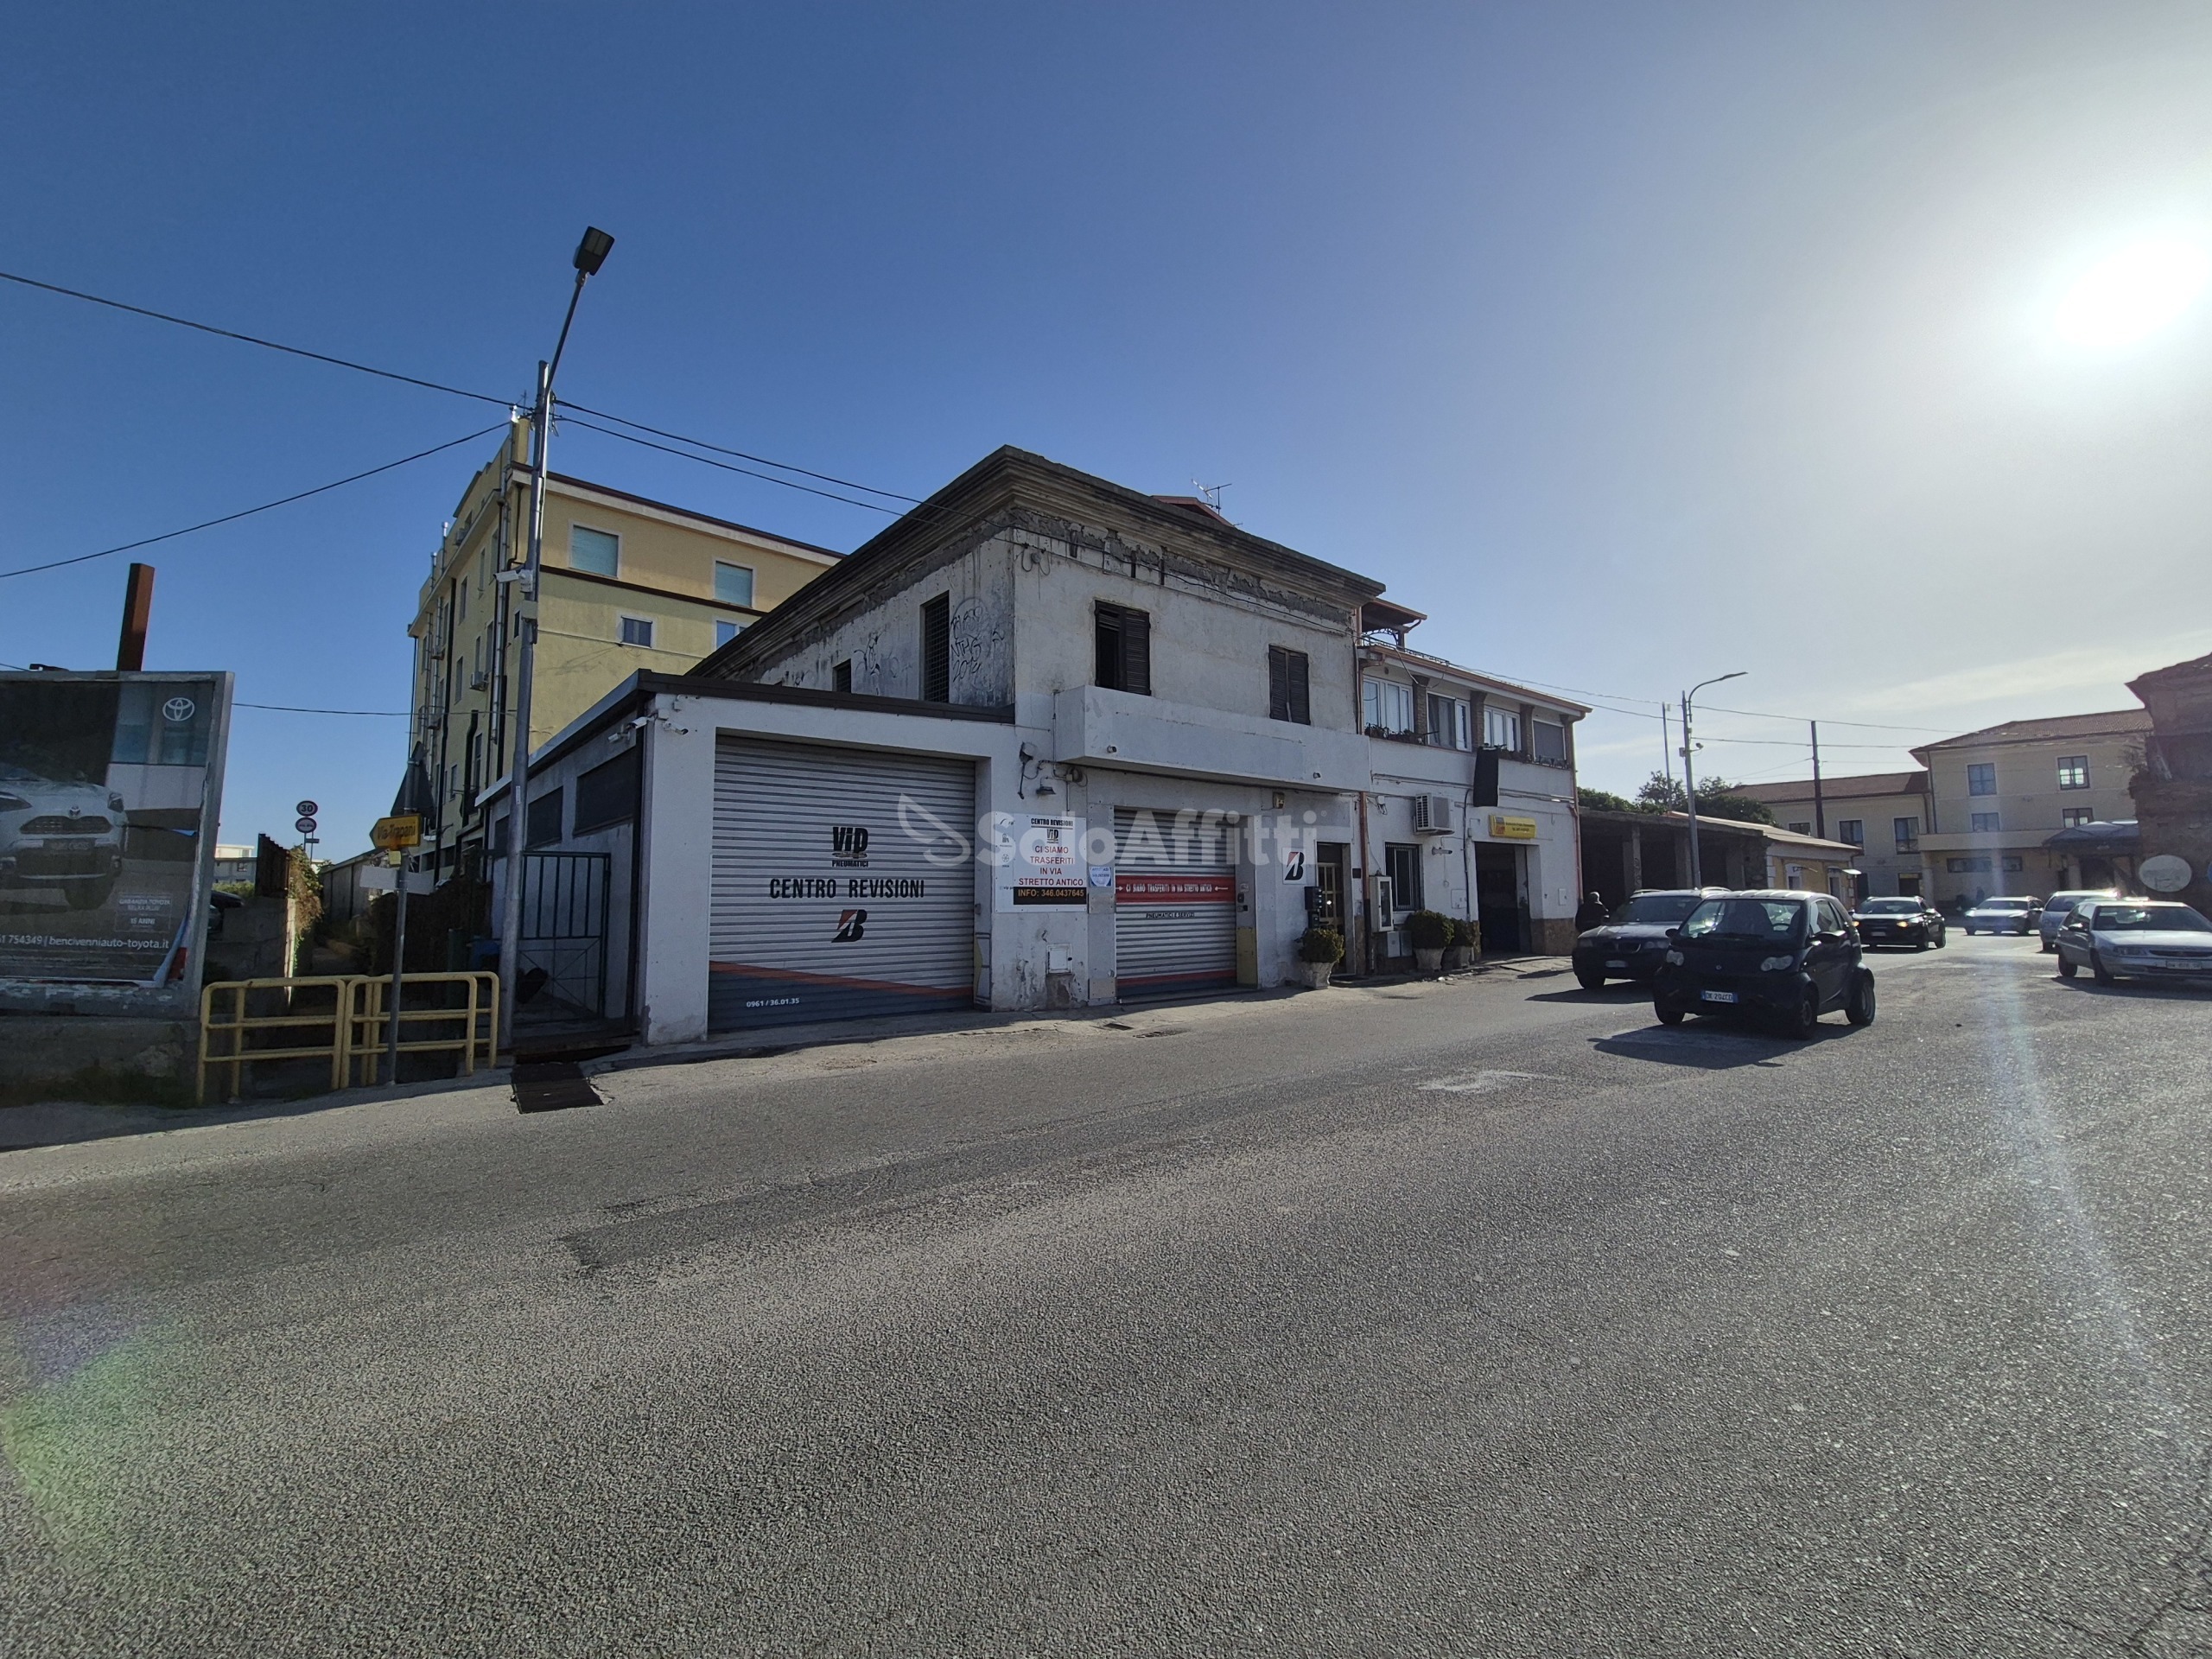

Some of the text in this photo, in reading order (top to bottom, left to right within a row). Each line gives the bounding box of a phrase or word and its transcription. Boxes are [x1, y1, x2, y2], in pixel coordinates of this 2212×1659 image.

[1034, 845, 1069, 854] CI SIAMO
[1030, 855, 1074, 865] TRASFERITI
[1039, 867, 1063, 875] IN VIA
[1018, 877, 1084, 887] STRETTO ANTICO
[769, 878, 925, 899] CENTRO REVISIONI
[1018, 888, 1039, 897] INFO:
[1040, 888, 1084, 897] 346.0437645
[9, 934, 42, 945] 754349
[48, 935, 169, 950] bencivenniauto-toyota.it
[770, 997, 800, 1007] 36.01.35
